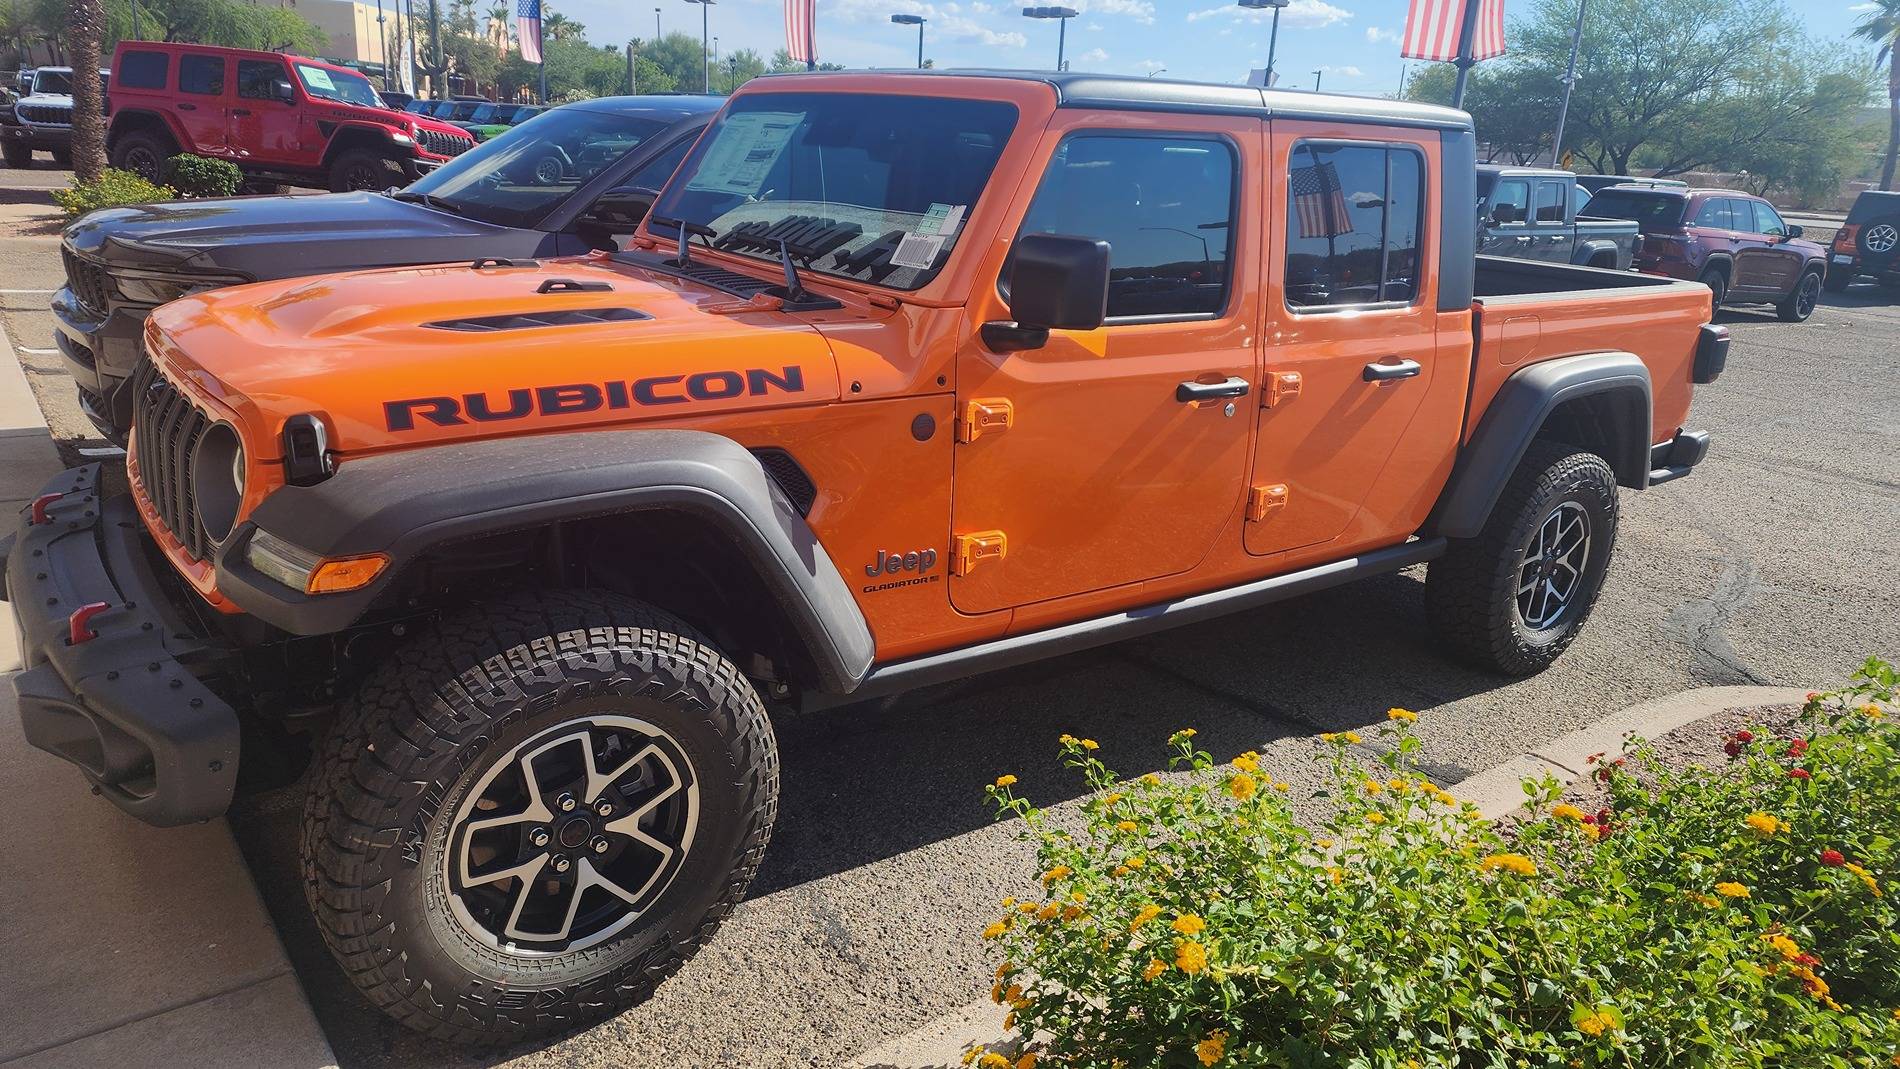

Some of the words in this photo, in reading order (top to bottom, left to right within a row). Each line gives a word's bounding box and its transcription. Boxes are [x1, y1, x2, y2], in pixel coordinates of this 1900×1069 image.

[383, 365, 804, 432] RUBICON
[865, 548, 937, 577] Jeep
[863, 577, 928, 593] GLADIATOR
